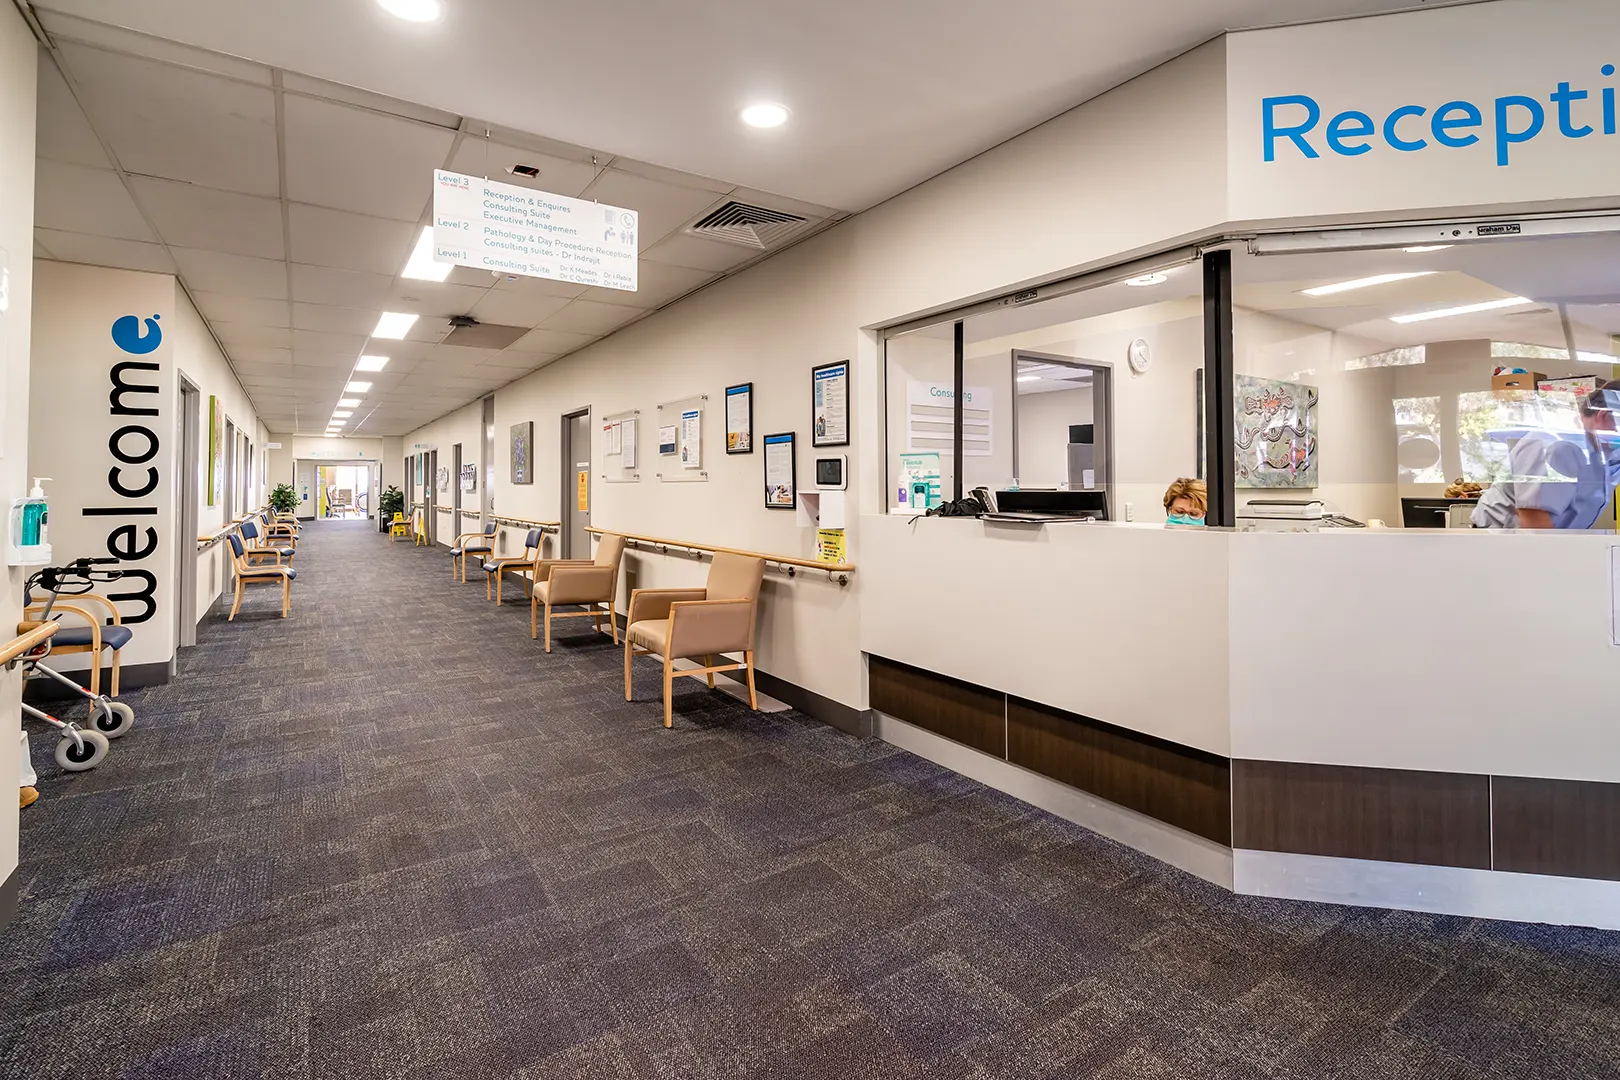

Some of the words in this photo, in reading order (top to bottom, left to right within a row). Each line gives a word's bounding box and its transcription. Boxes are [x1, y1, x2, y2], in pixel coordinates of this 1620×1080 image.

[1262, 64, 1616, 167] Recepti
[438, 173, 460, 184] Level
[463, 178, 469, 186] 3
[483, 188, 526, 204] Reception
[528, 198, 534, 206] &
[537, 199, 571, 213] Enquires
[483, 200, 528, 217] Consulting
[530, 209, 551, 220] Suite
[438, 217, 460, 229] Level
[463, 222, 469, 231] 2
[483, 211, 524, 226] Executive
[526, 219, 577, 236] Management
[483, 238, 528, 254] Consulting
[530, 246, 554, 257] suites
[561, 251, 572, 259] Dr
[484, 226, 526, 242] Pathology
[528, 234, 535, 243] &
[537, 236, 553, 247] Day
[555, 239, 594, 253] Procedure
[596, 246, 632, 259] Reception
[437, 247, 460, 258] Level
[463, 251, 467, 260] 1
[483, 256, 527, 272] Consulting
[530, 264, 550, 274] Suite
[604, 271, 611, 279] Dr
[930, 386, 972, 403] Consung
